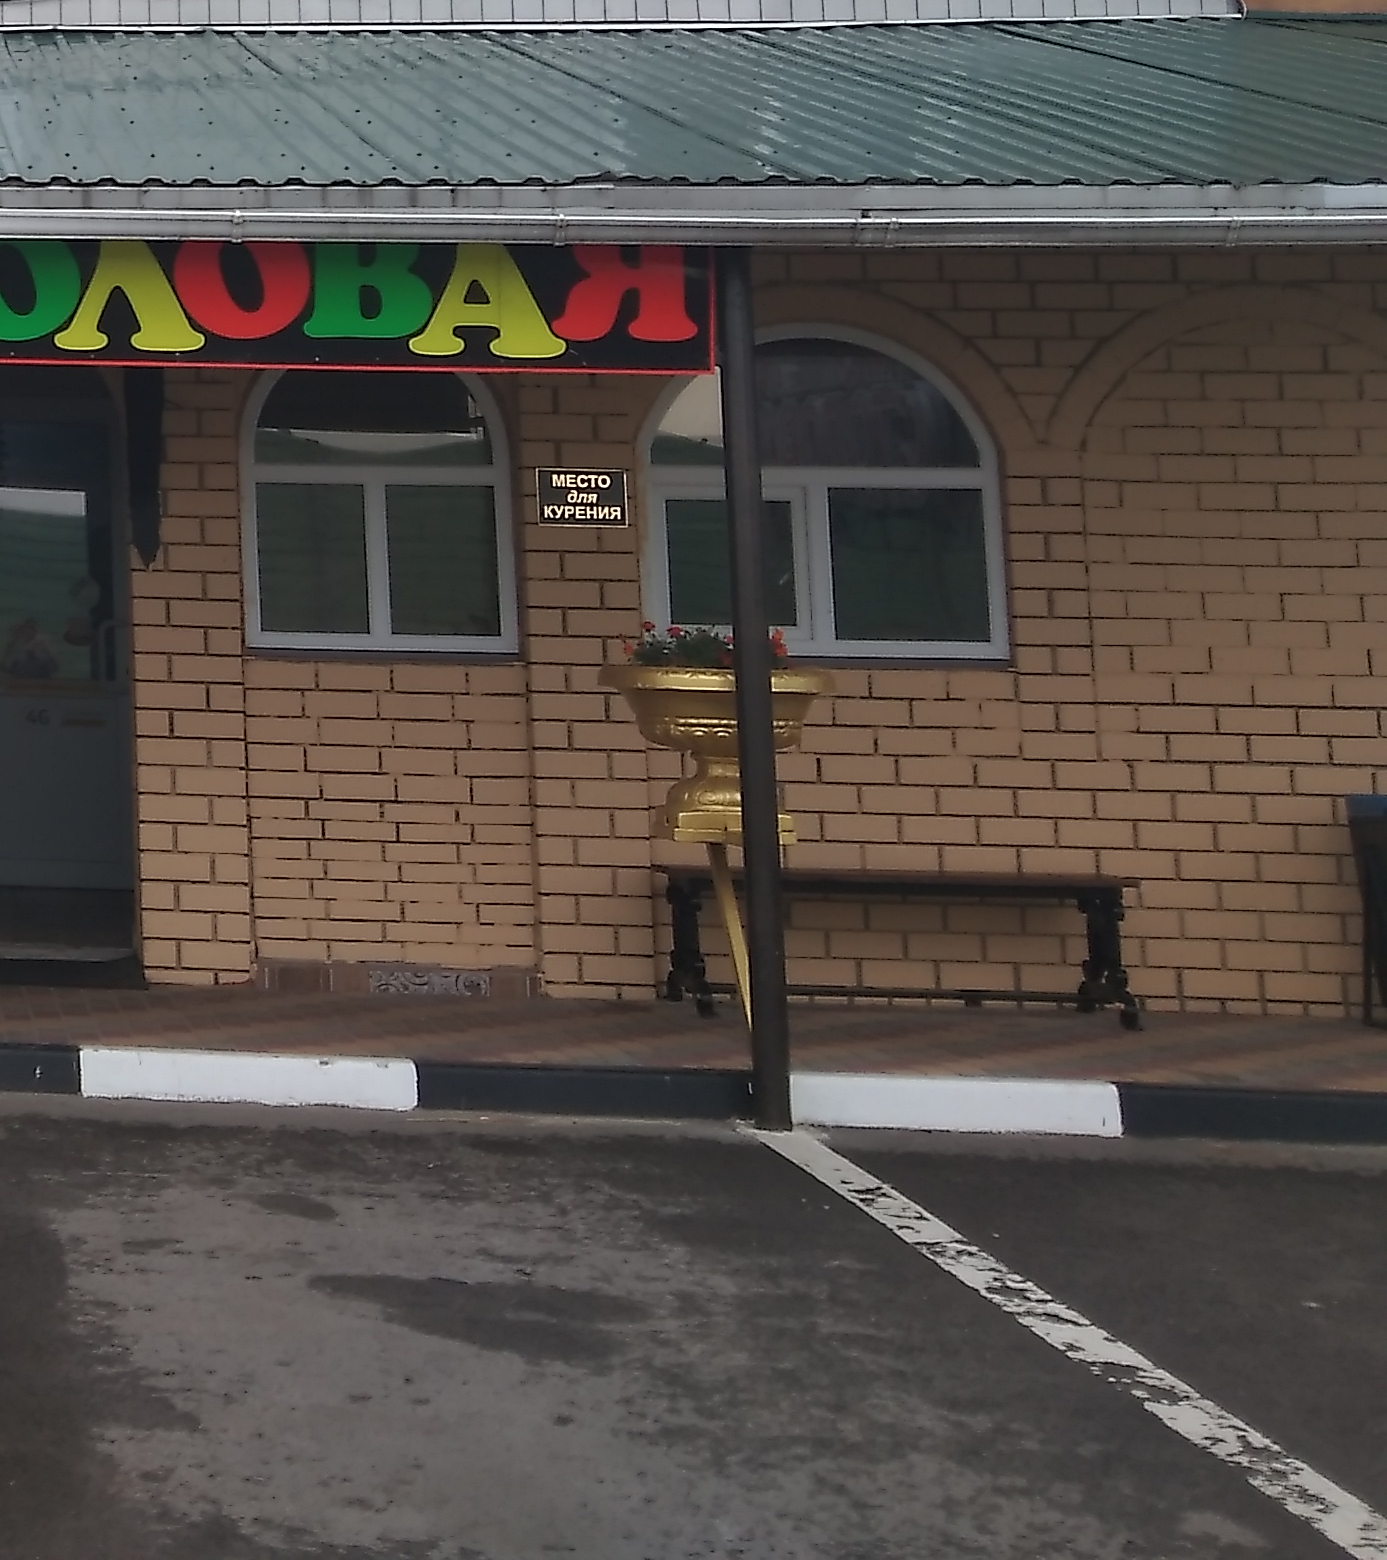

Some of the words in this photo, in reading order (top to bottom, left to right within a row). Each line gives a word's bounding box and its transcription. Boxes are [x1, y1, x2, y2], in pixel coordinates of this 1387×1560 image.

[552, 474, 611, 489] МЕСТО
[567, 490, 598, 504] для
[543, 505, 622, 520] КУРЕНИЯ
